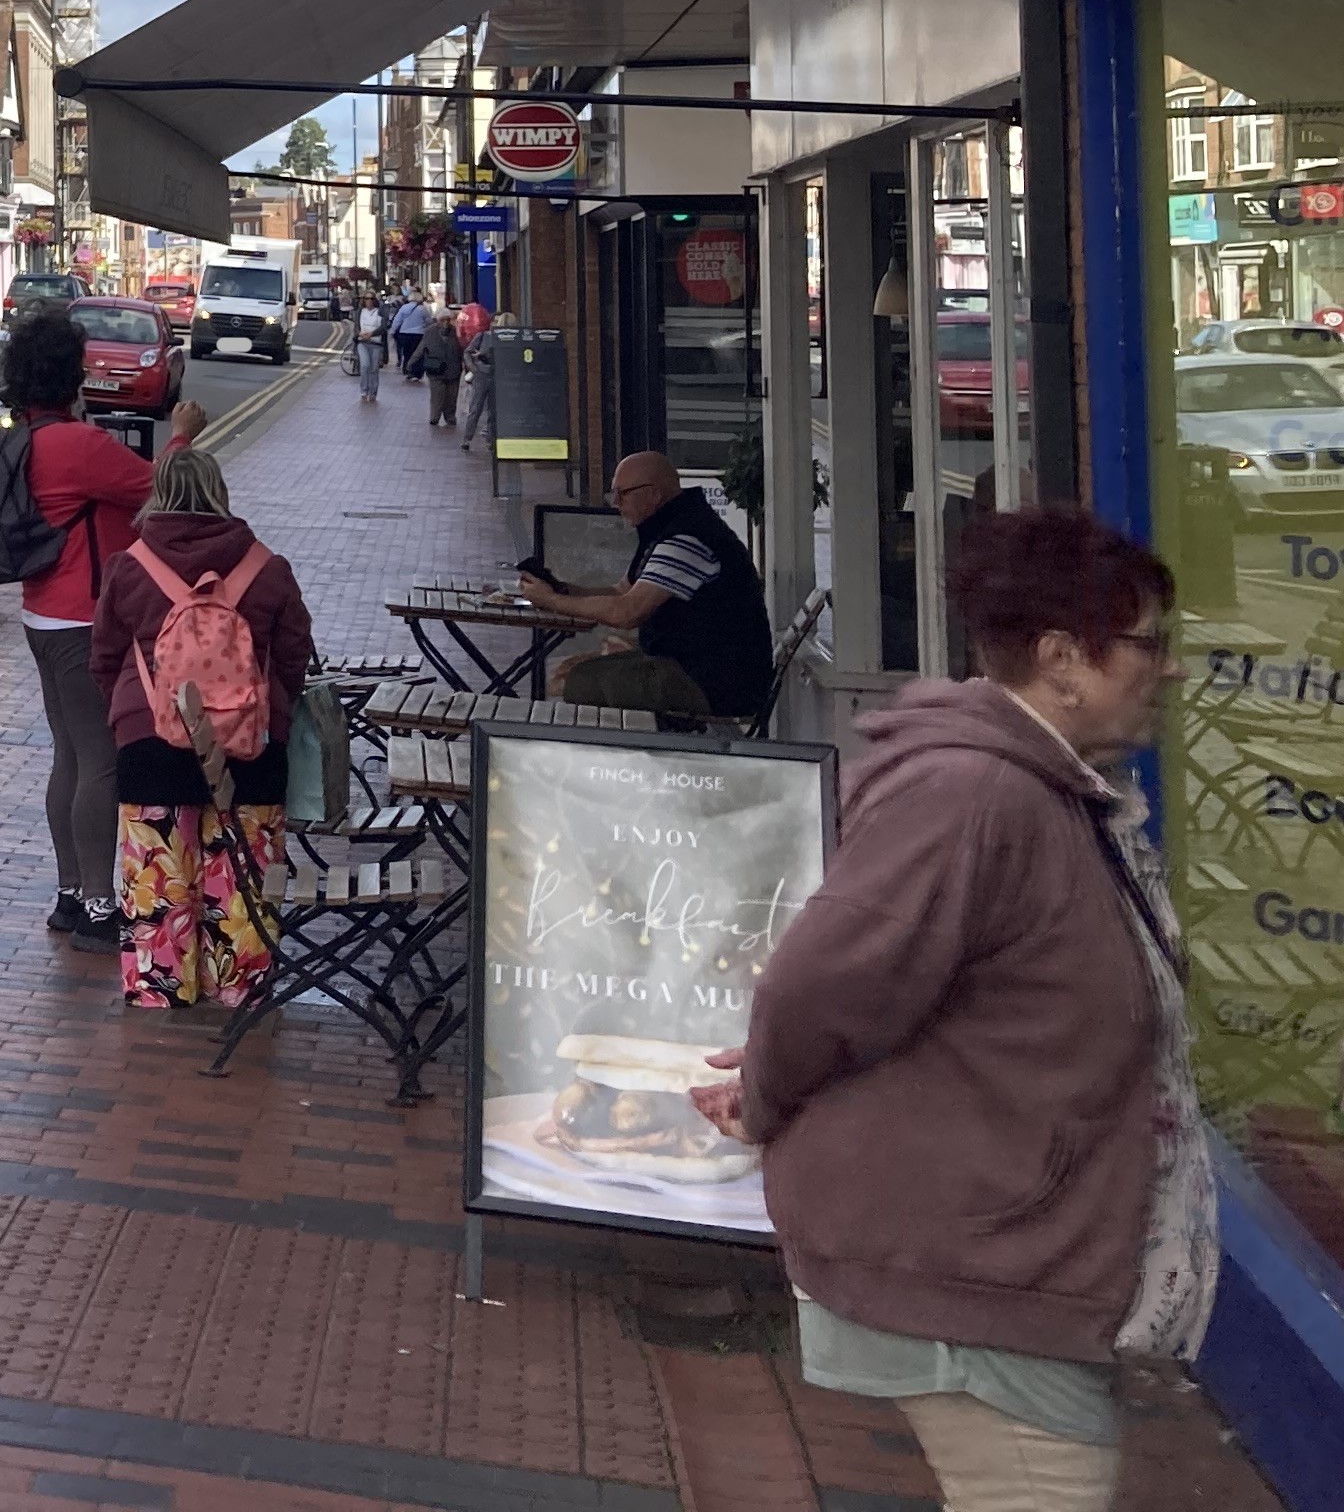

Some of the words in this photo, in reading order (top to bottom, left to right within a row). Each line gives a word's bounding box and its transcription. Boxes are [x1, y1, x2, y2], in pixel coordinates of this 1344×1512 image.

[491, 127, 578, 146] WIMPY
[457, 214, 502, 223] shoezone
[685, 241, 740, 252] CLASSIC
[687, 261, 721, 271] SOLD
[687, 271, 721, 281] HERE
[1281, 534, 1344, 582] To
[589, 766, 644, 784] FINCH
[664, 771, 726, 791] HOUSE
[613, 823, 701, 849] ENJOY
[525, 856, 807, 953] Breakfast
[490, 962, 559, 990] THE
[576, 971, 673, 1004] MEGA
[693, 983, 752, 1011] MU
